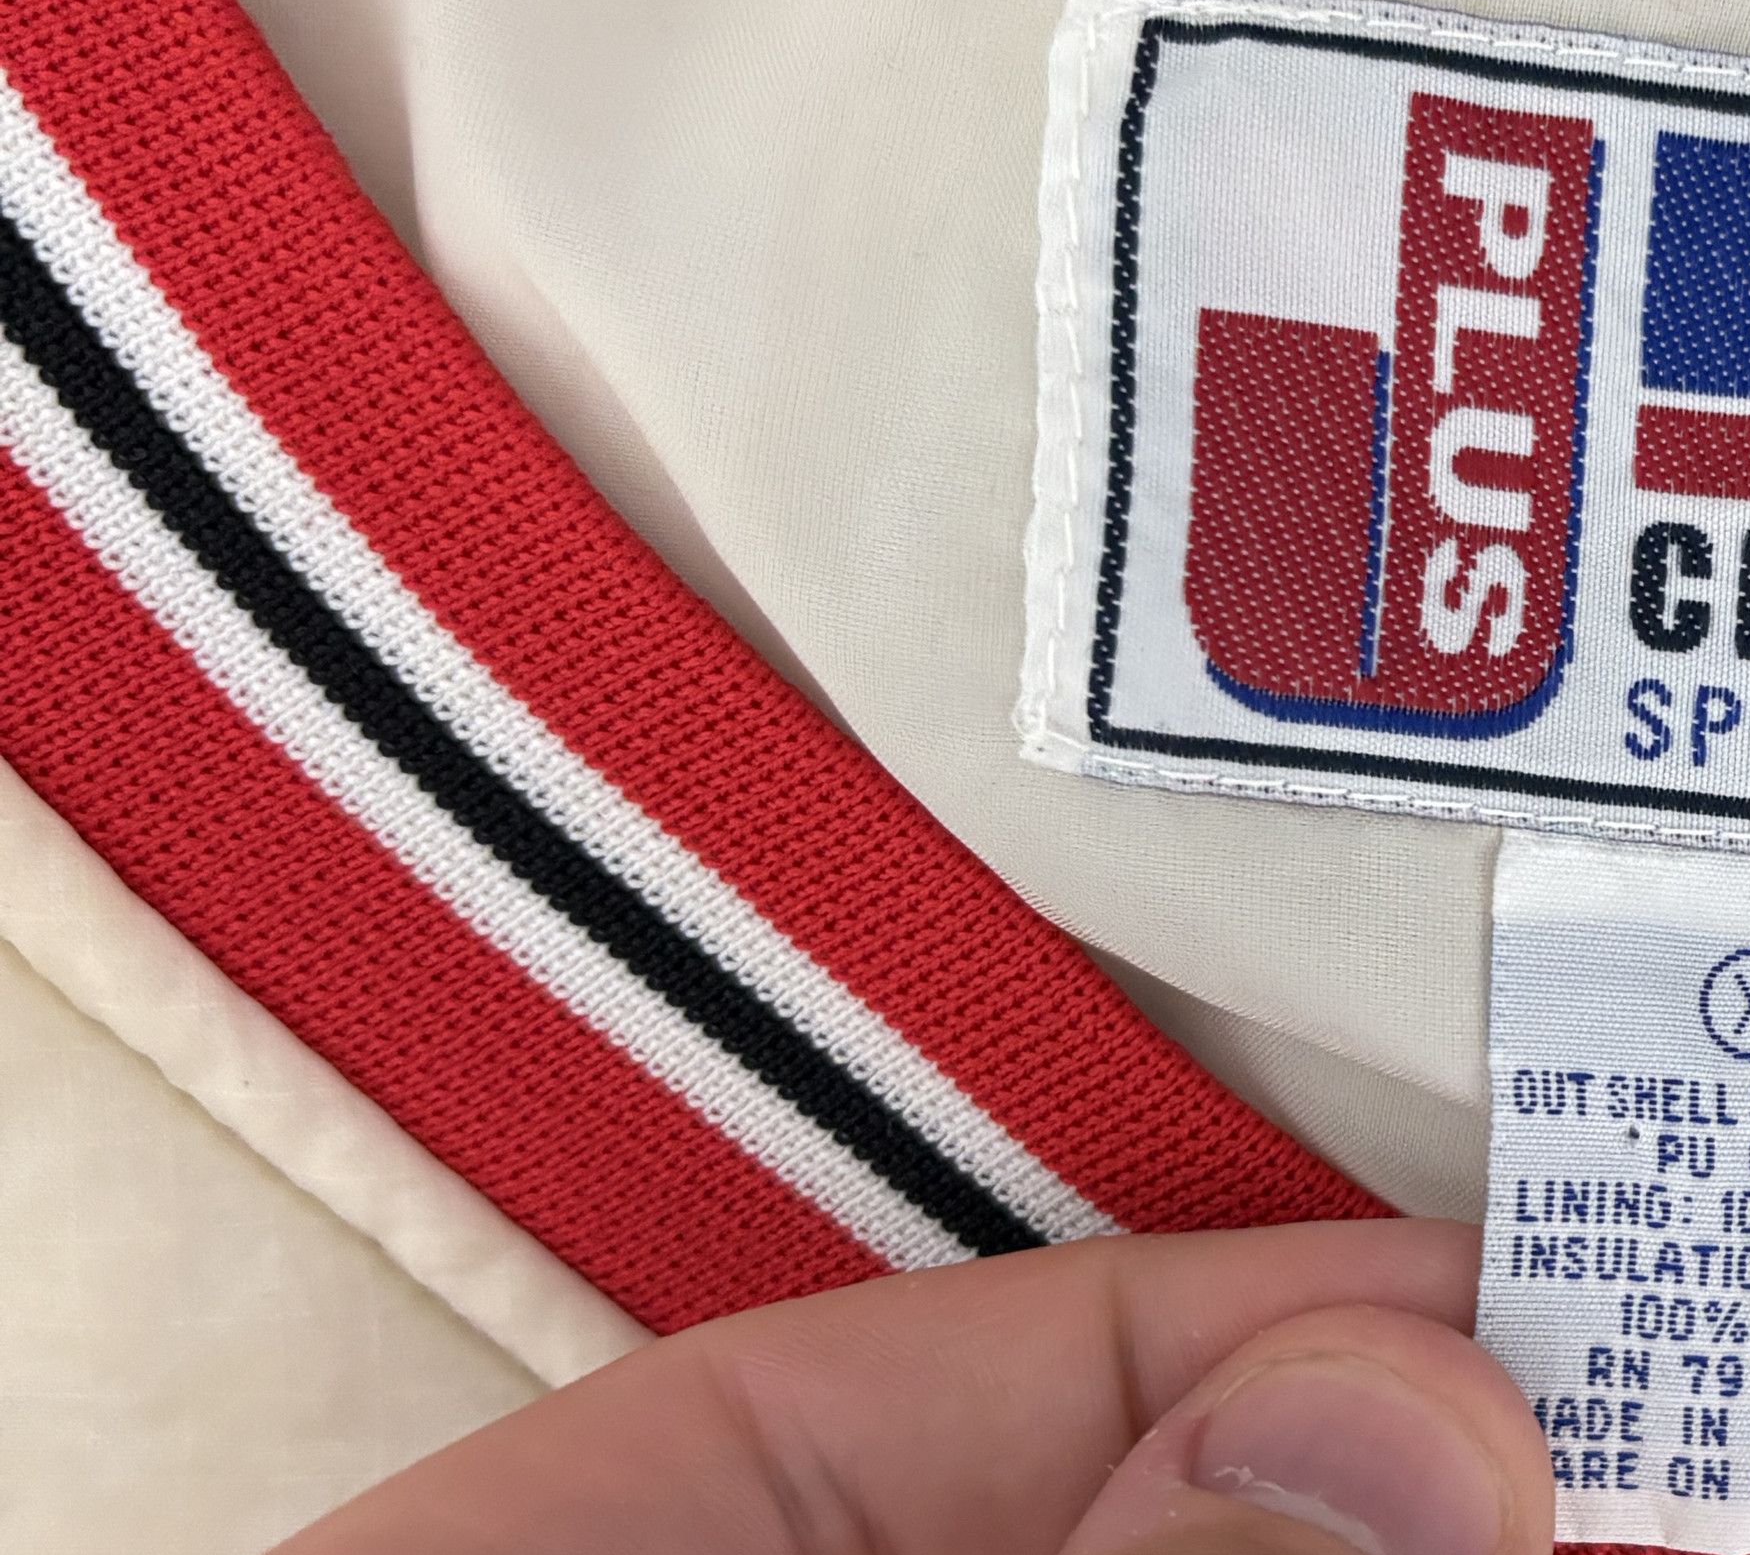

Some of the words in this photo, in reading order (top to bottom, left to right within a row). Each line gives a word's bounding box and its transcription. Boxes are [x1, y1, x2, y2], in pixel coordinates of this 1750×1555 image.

[1417, 153, 1554, 657] PLUS
[1513, 1070, 1595, 1116] OUT
[1656, 1134, 1715, 1178] PU
[1516, 1178, 1694, 1228] LINING:
[1620, 1293, 1750, 1343] 100%
[1586, 1347, 1651, 1389] RN
[1682, 1406, 1728, 1446] IN
[1668, 1457, 1729, 1501] ON
